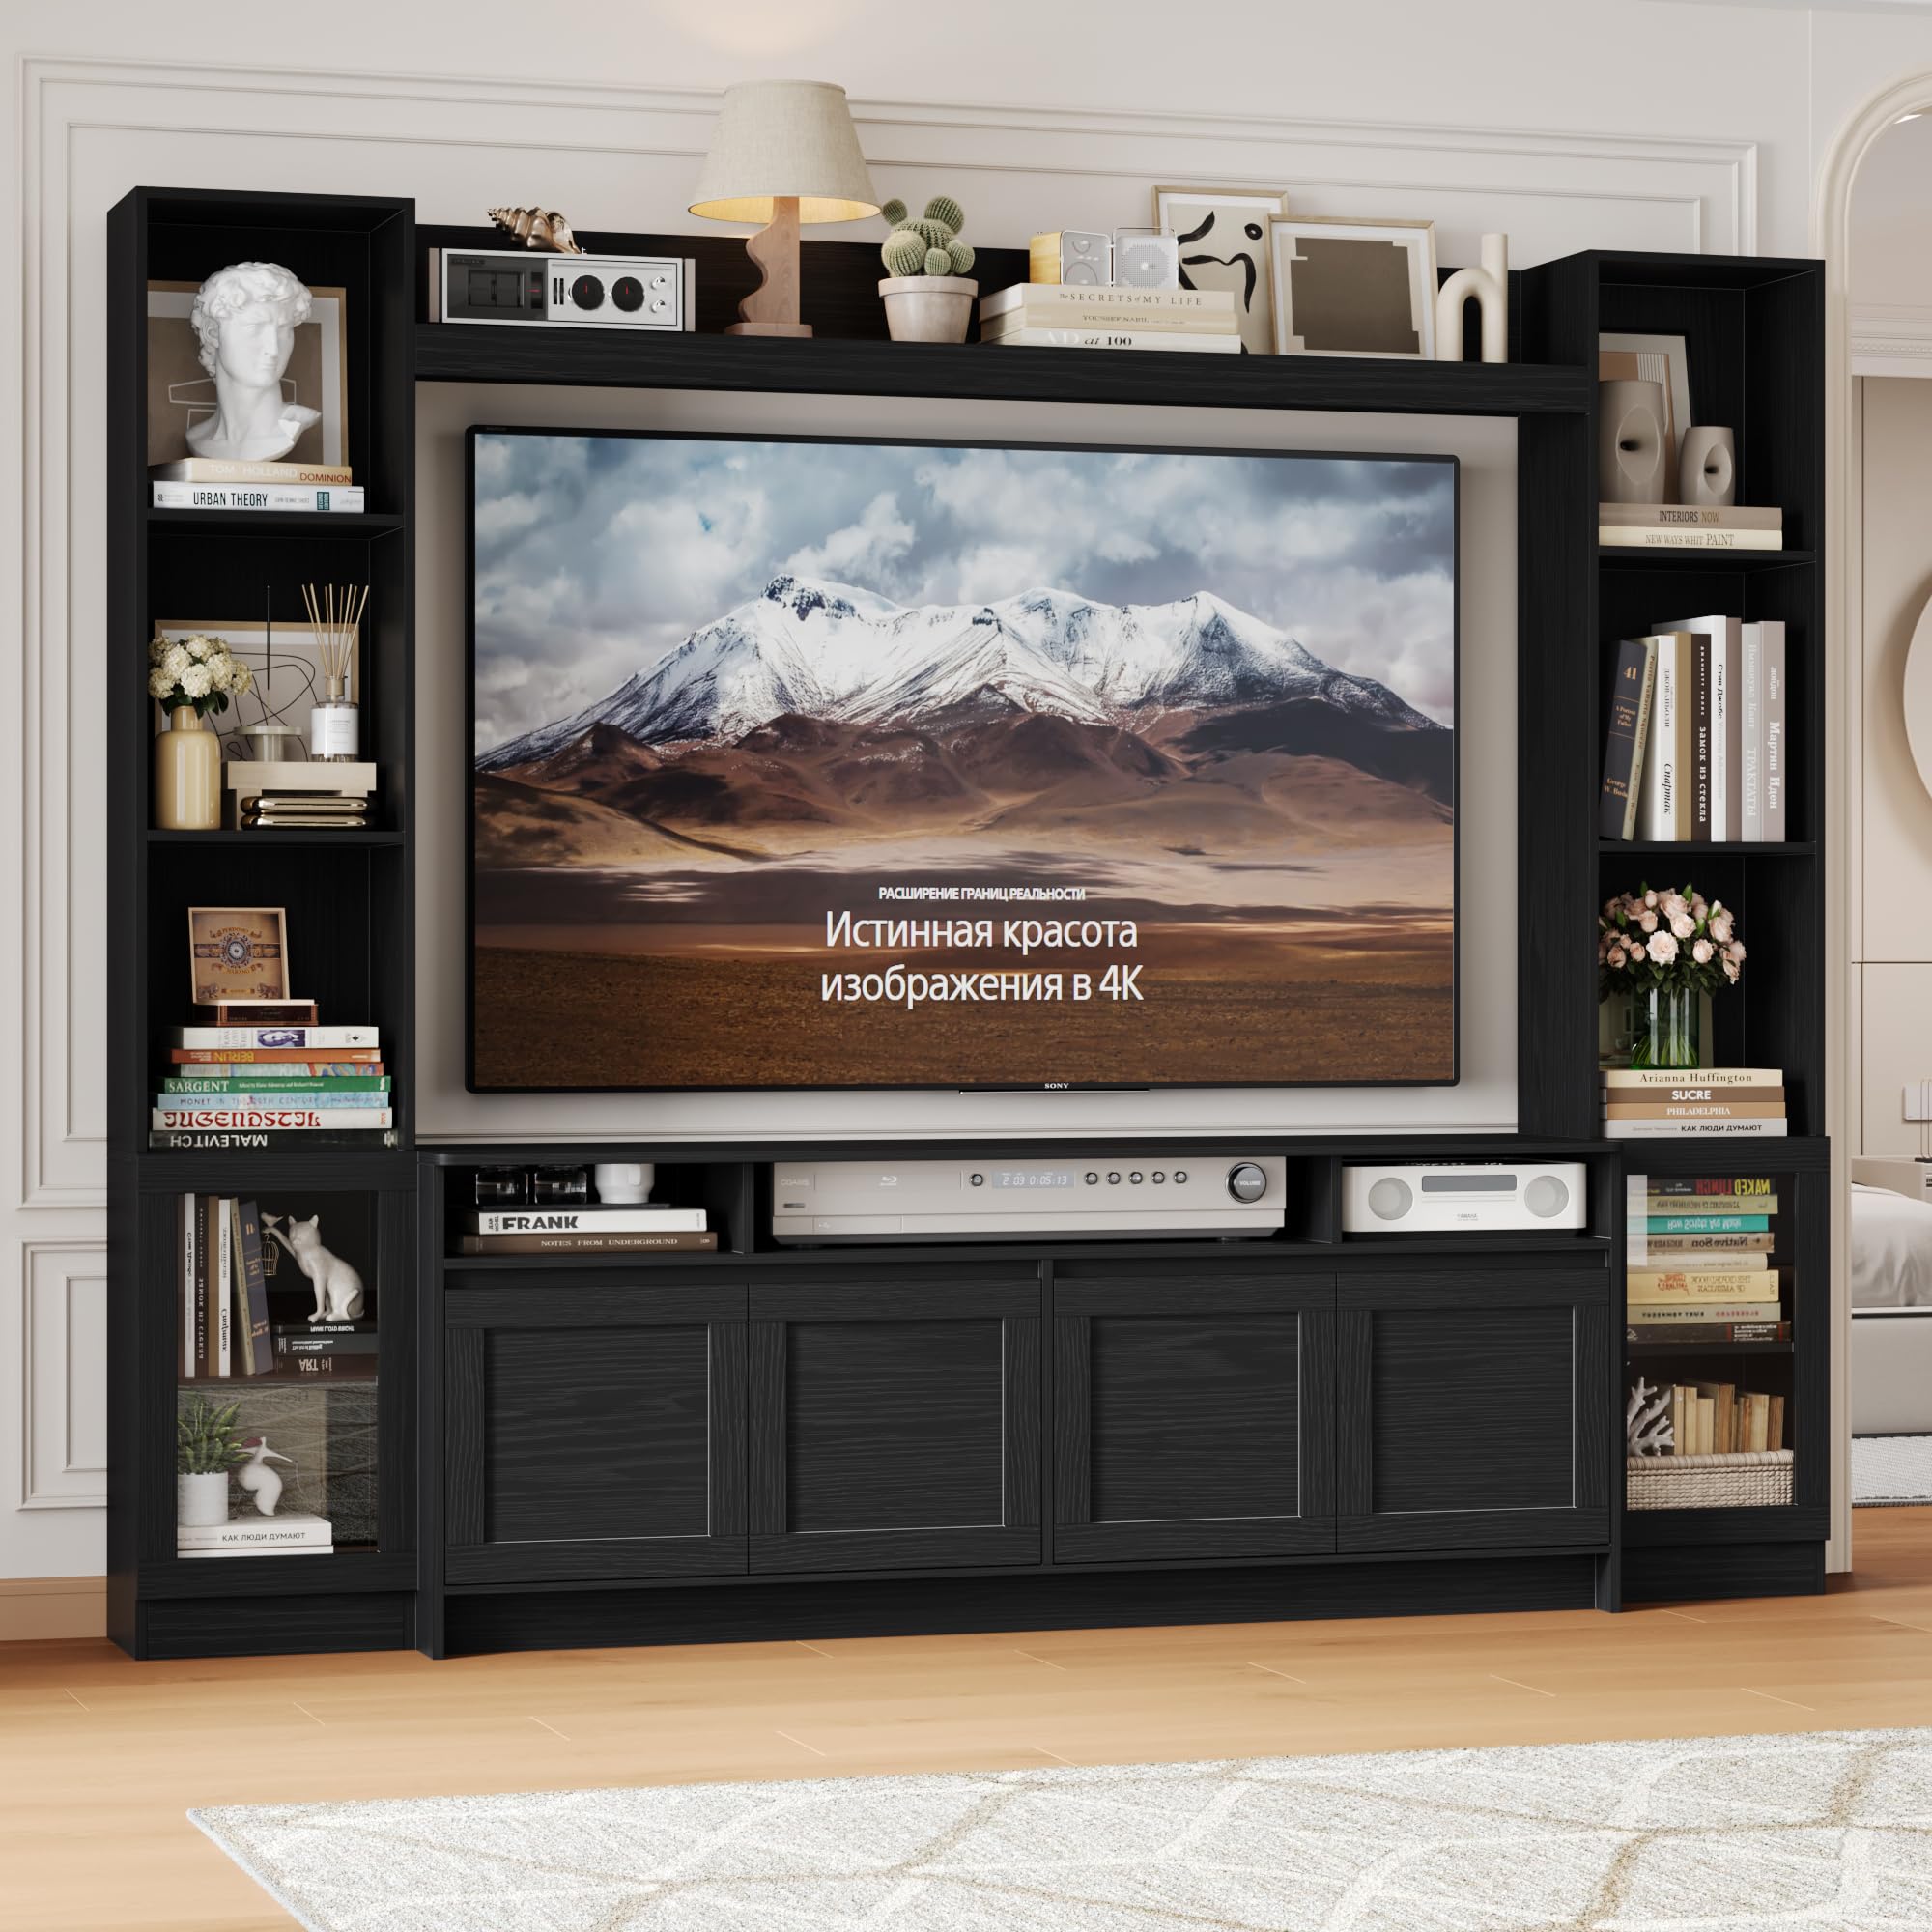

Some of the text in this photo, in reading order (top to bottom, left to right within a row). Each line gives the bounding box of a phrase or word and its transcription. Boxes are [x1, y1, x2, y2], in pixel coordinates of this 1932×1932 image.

[1069, 293, 1134, 303] SECRETS
[1143, 296, 1162, 304] MY
[1171, 296, 1202, 306] LIFE
[1107, 336, 1132, 346] 100
[209, 464, 298, 477] TOM HOLLAND
[299, 472, 352, 484] DOMINION
[193, 491, 226, 506] URBAN
[231, 493, 269, 508] THEORY
[1659, 510, 1720, 523] INTERIORS NOW
[1645, 534, 1662, 544] NEW
[1663, 535, 1683, 545] WAYS
[1706, 533, 1735, 546] PAINT
[1623, 666, 1637, 680] 41
[1768, 721, 1780, 810] Мартин Иден
[1699, 766, 1707, 780] из
[1747, 747, 1757, 817] ТРАКТАТЫ
[1662, 763, 1674, 815] Спартак
[878, 887, 1086, 902] РАСШИРЕНИЕ ГРАНИЦ РЕАЛЬНОСТИ
[826, 910, 1137, 955] Истинная красота
[821, 963, 1063, 1010] изображения
[1073, 974, 1092, 1001] в
[213, 1051, 254, 1062] BERLIN
[1639, 1072, 1753, 1085] Arianna Huffington
[169, 1080, 229, 1093] SARGENT
[1671, 1090, 1712, 1100] SUCRE
[1666, 1107, 1731, 1116] PHILADELPHIA
[164, 1111, 322, 1128] JUGENDSTIL
[170, 1134, 269, 1148] MALEVITCH
[502, 1215, 579, 1230] FRANK
[541, 1239, 572, 1248] NOTES
[608, 1237, 679, 1246] UNDERGROUND
[269, 1532, 306, 1541] ДУМАЮТ
